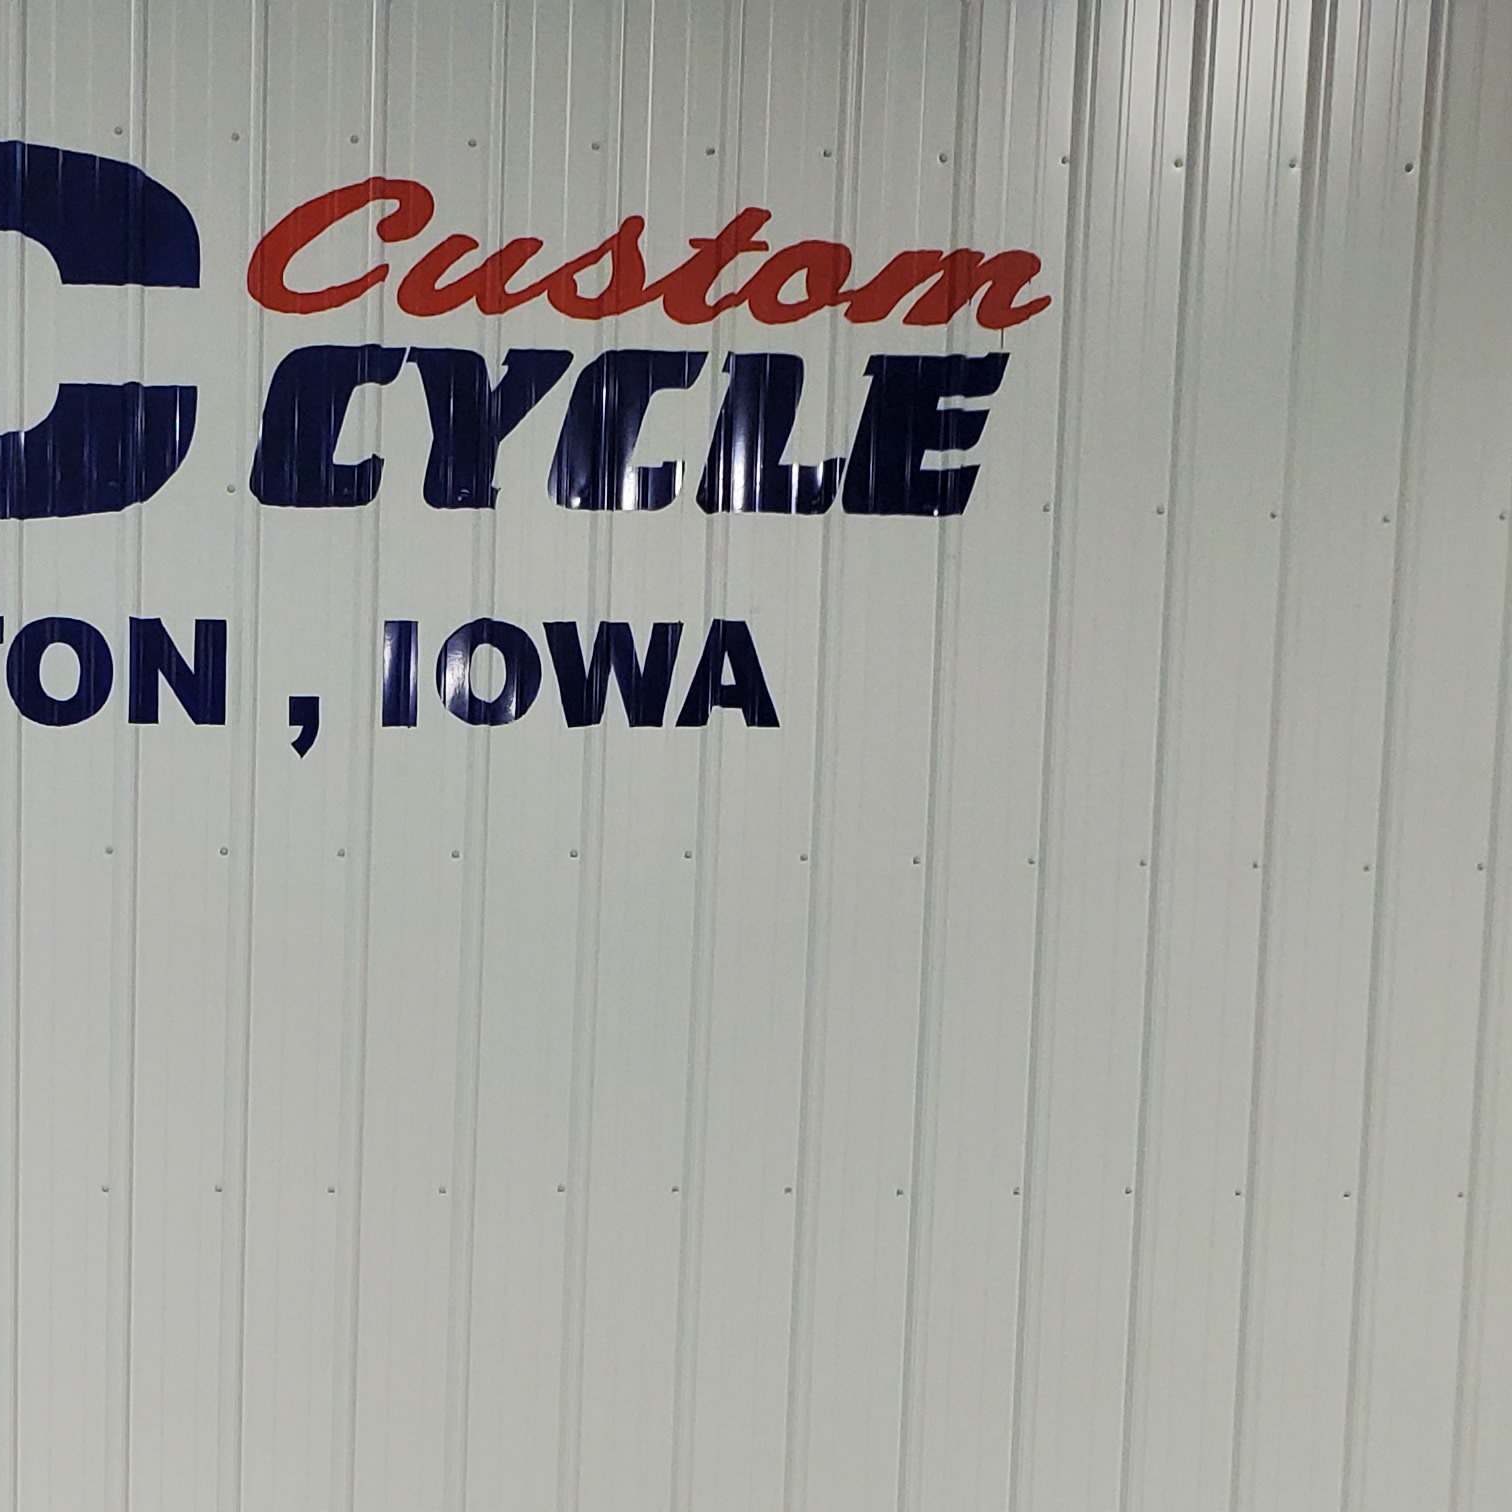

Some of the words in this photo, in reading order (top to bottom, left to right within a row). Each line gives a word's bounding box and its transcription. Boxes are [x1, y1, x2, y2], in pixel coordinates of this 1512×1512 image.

[247, 177, 1050, 329] Custom
[250, 344, 1009, 516] CYCLE
[382, 618, 780, 727] IOWA
